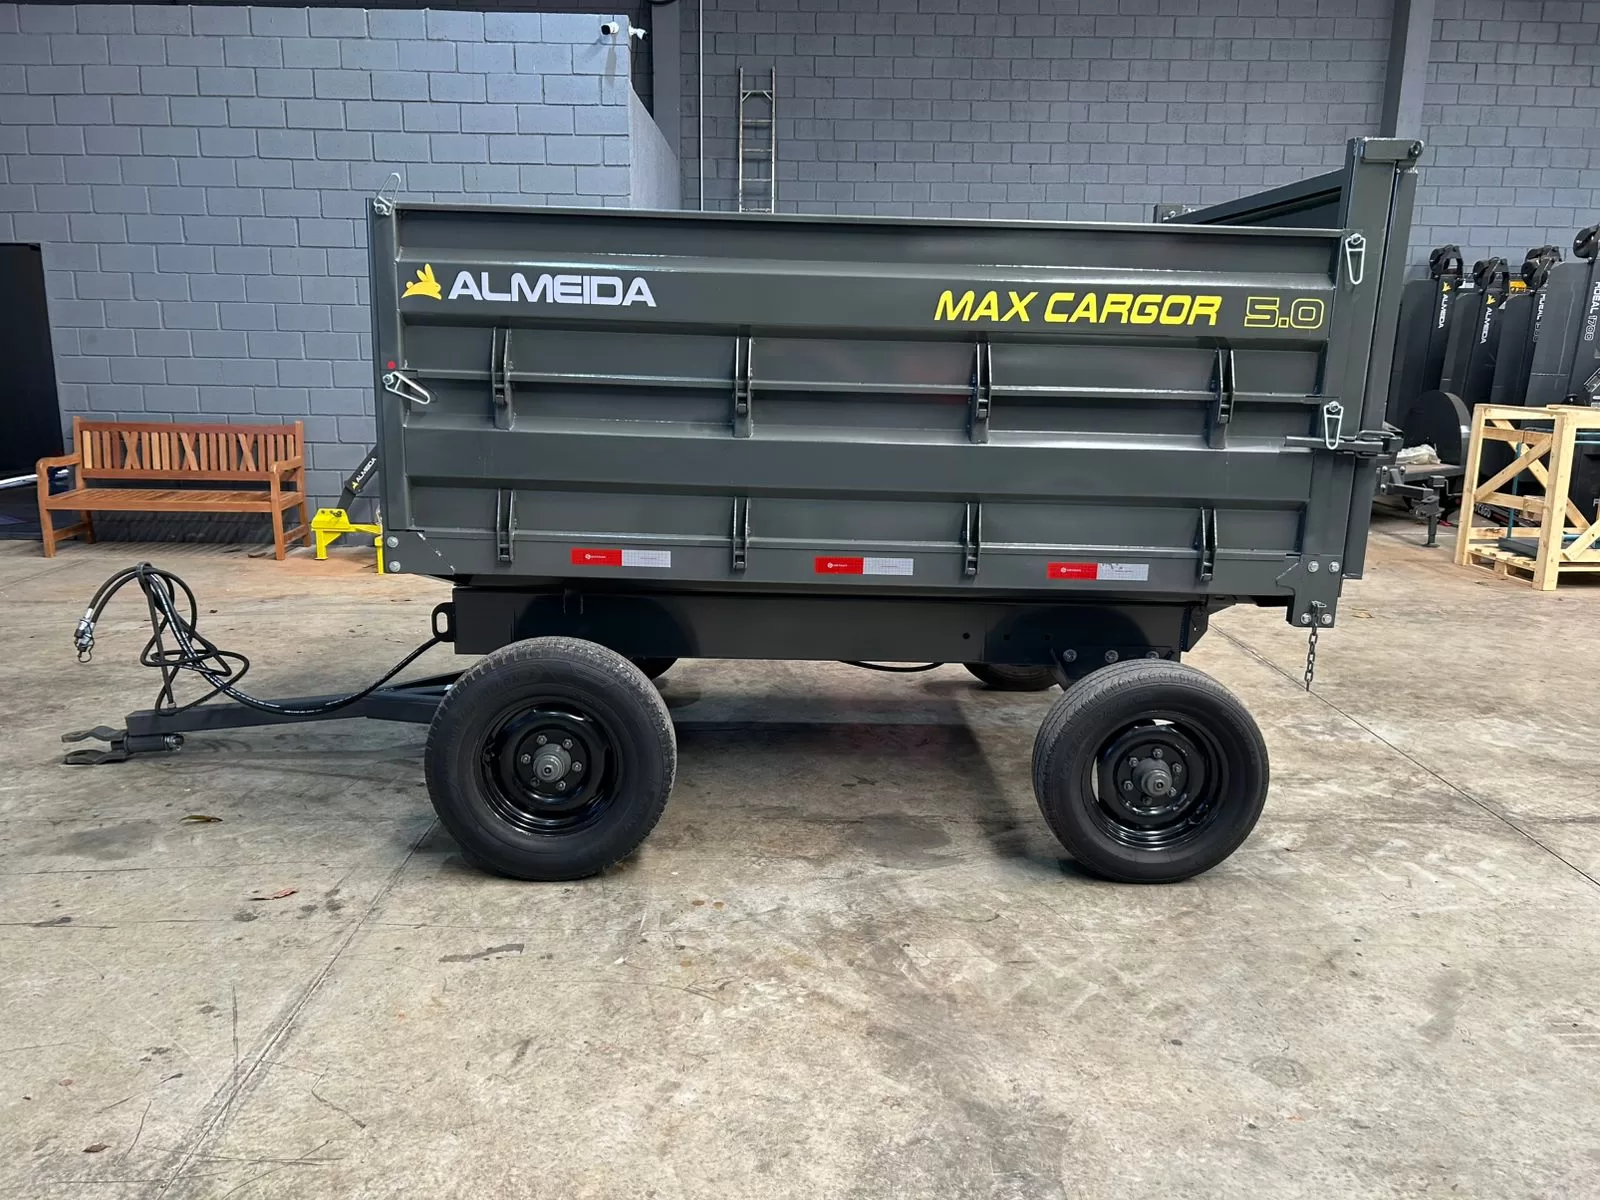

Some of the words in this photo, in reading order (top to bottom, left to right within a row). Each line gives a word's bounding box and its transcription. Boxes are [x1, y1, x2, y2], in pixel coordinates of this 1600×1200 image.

[448, 270, 657, 308] ALMEIDA
[933, 289, 1038, 322] MAX
[1043, 292, 1222, 326] CARGOR
[1243, 296, 1325, 329] 5.0
[1438, 293, 1449, 329] ALMEIDA
[1480, 306, 1493, 344] ALMEIDA
[355, 457, 377, 483] ALMEIDA
